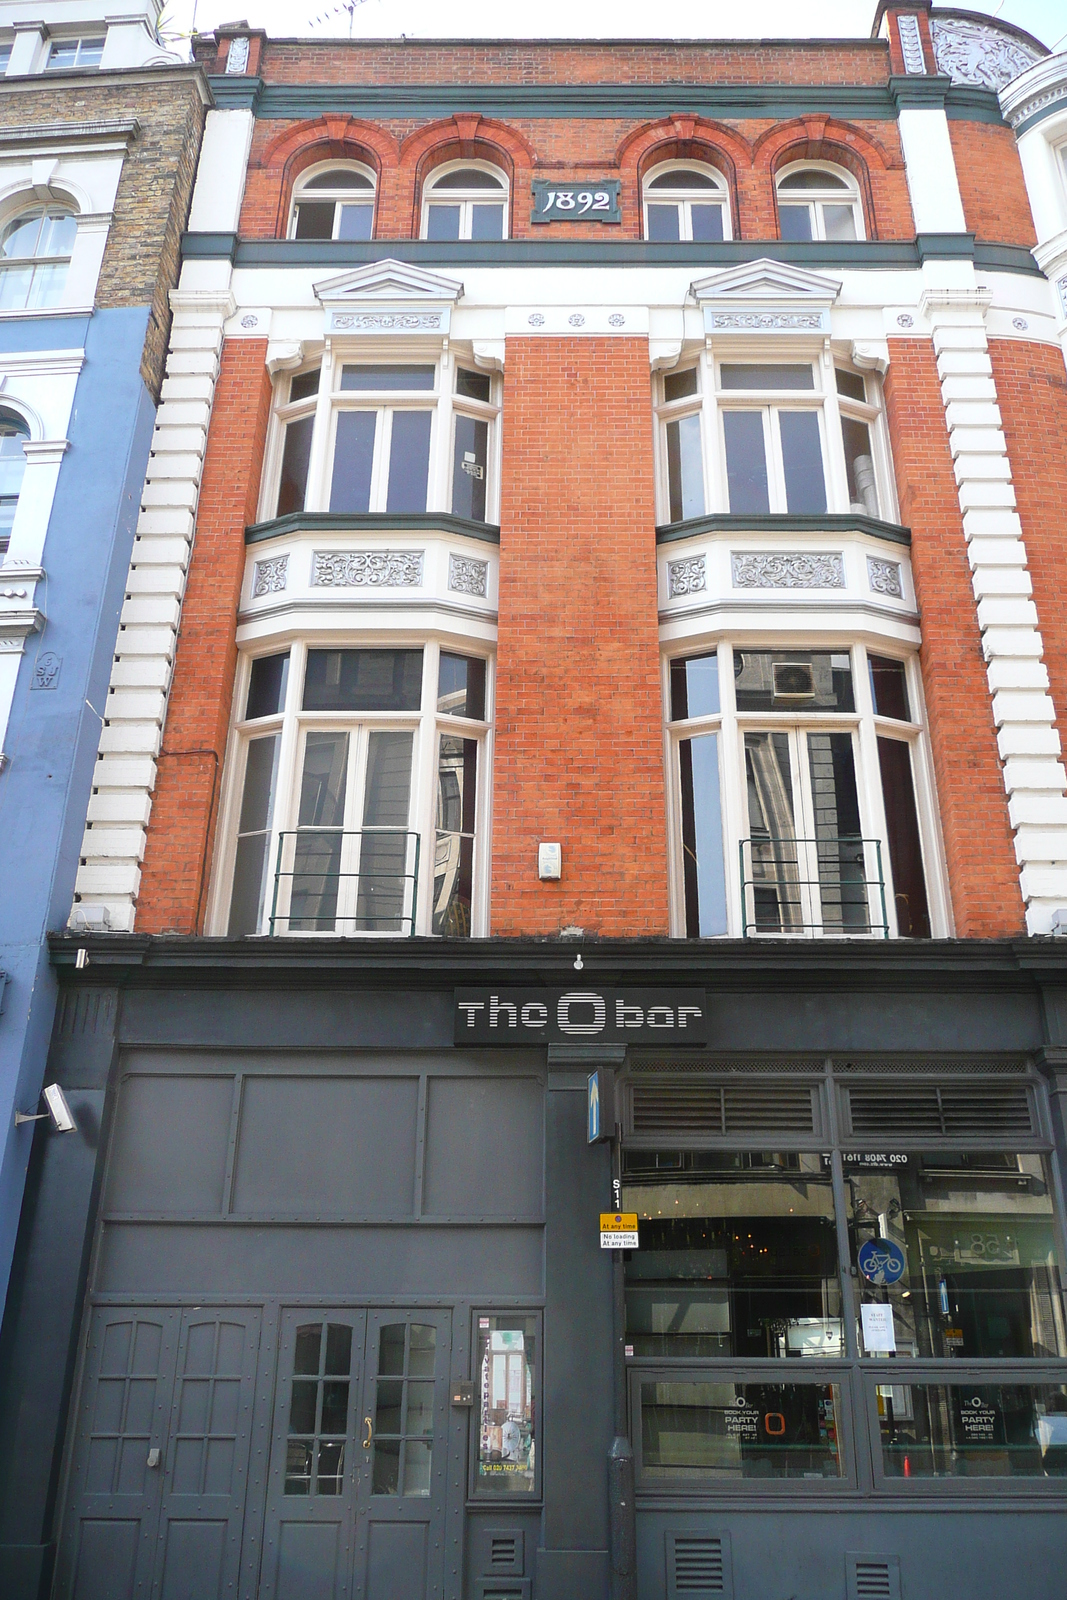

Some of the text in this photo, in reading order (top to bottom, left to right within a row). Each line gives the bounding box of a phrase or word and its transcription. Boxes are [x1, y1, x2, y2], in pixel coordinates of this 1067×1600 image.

[542, 191, 610, 215] 1892
[458, 992, 702, 1035] The O bar
